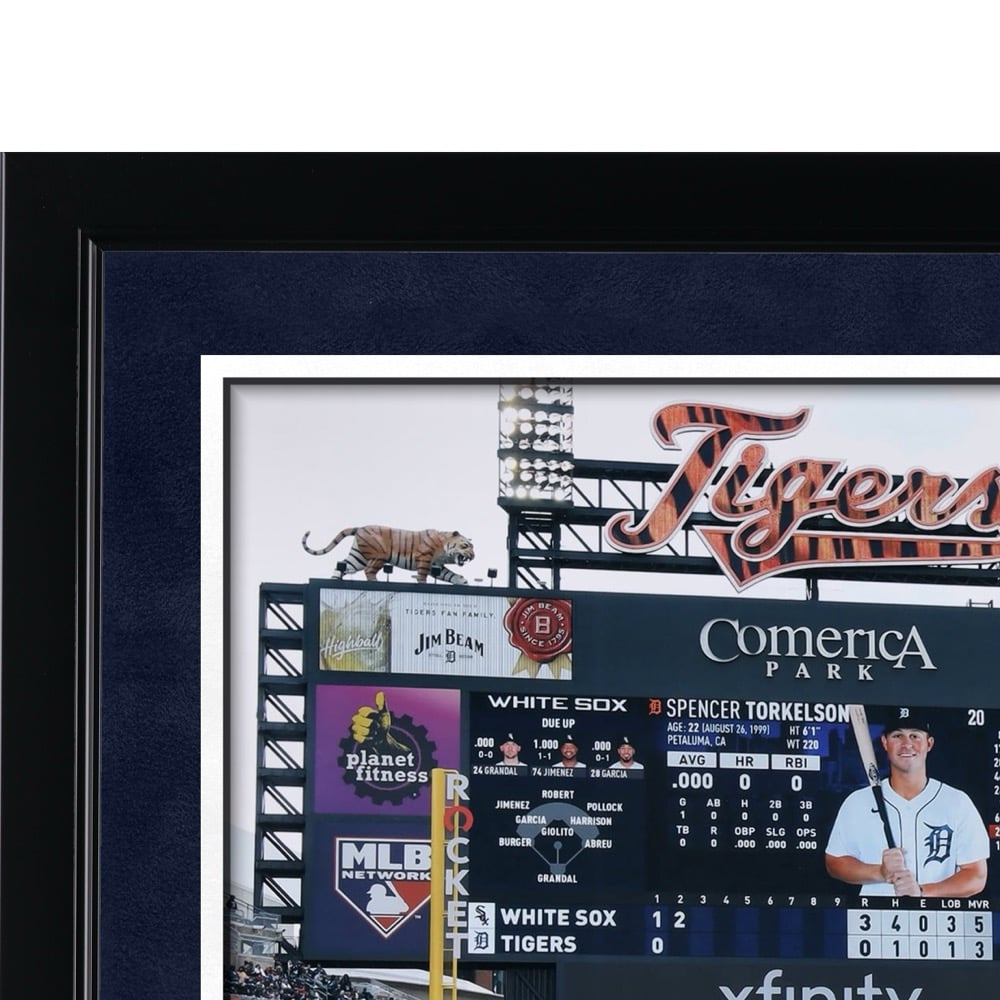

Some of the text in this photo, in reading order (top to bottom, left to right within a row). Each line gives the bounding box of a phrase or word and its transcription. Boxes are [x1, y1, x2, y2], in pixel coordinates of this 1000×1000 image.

[520, 602, 564, 622] JIM BEAM
[520, 626, 566, 647] SINCE 1795
[320, 632, 383, 659] Highball
[414, 628, 484, 657] JIM BEAM
[766, 661, 873, 681] PARK
[488, 695, 628, 712] WHITE SOX
[666, 698, 850, 723] SPENCER TORKELSON
[968, 709, 984, 726] 20
[542, 718, 576, 729] DUE UP
[667, 722, 687, 732] AGE:
[688, 722, 700, 733] 22
[736, 724, 748, 735] 26,
[790, 726, 800, 736] HT
[534, 739, 558, 750] 1.000
[668, 735, 726, 746] PETALUMA, CA
[786, 739, 820, 750] WT 220
[346, 750, 414, 769] planet
[679, 755, 706, 765] AVG
[736, 756, 754, 767] HR
[785, 758, 808, 768] RBI
[356, 766, 428, 783] fitness
[484, 767, 518, 776] GRANDAL
[544, 768, 574, 777] JIMENEZ
[602, 770, 628, 778] GARCIA
[672, 772, 714, 789] .000
[542, 790, 574, 800] ROBERT
[496, 800, 530, 810] JIMENEZ
[586, 802, 624, 812] POLLOCK
[516, 816, 546, 824] GARCIA
[570, 816, 612, 826] HARRISON
[541, 828, 574, 837] GIOLITO
[734, 827, 756, 836] OBP
[766, 828, 786, 837] SLG
[796, 828, 816, 837] OPS
[499, 838, 532, 847] BURGER
[584, 840, 612, 849] ABREU
[734, 840, 756, 848] .000
[765, 840, 786, 849] .000
[796, 841, 817, 850] .000
[342, 842, 431, 871] MLB
[443, 774, 474, 959] ROCKET
[342, 870, 431, 880] NETWORK
[538, 874, 578, 884] GRANDAL
[942, 900, 961, 908] LOB
[968, 900, 989, 909] MVR
[500, 908, 617, 927] WHITE SOX
[501, 934, 577, 953] TIGERS
